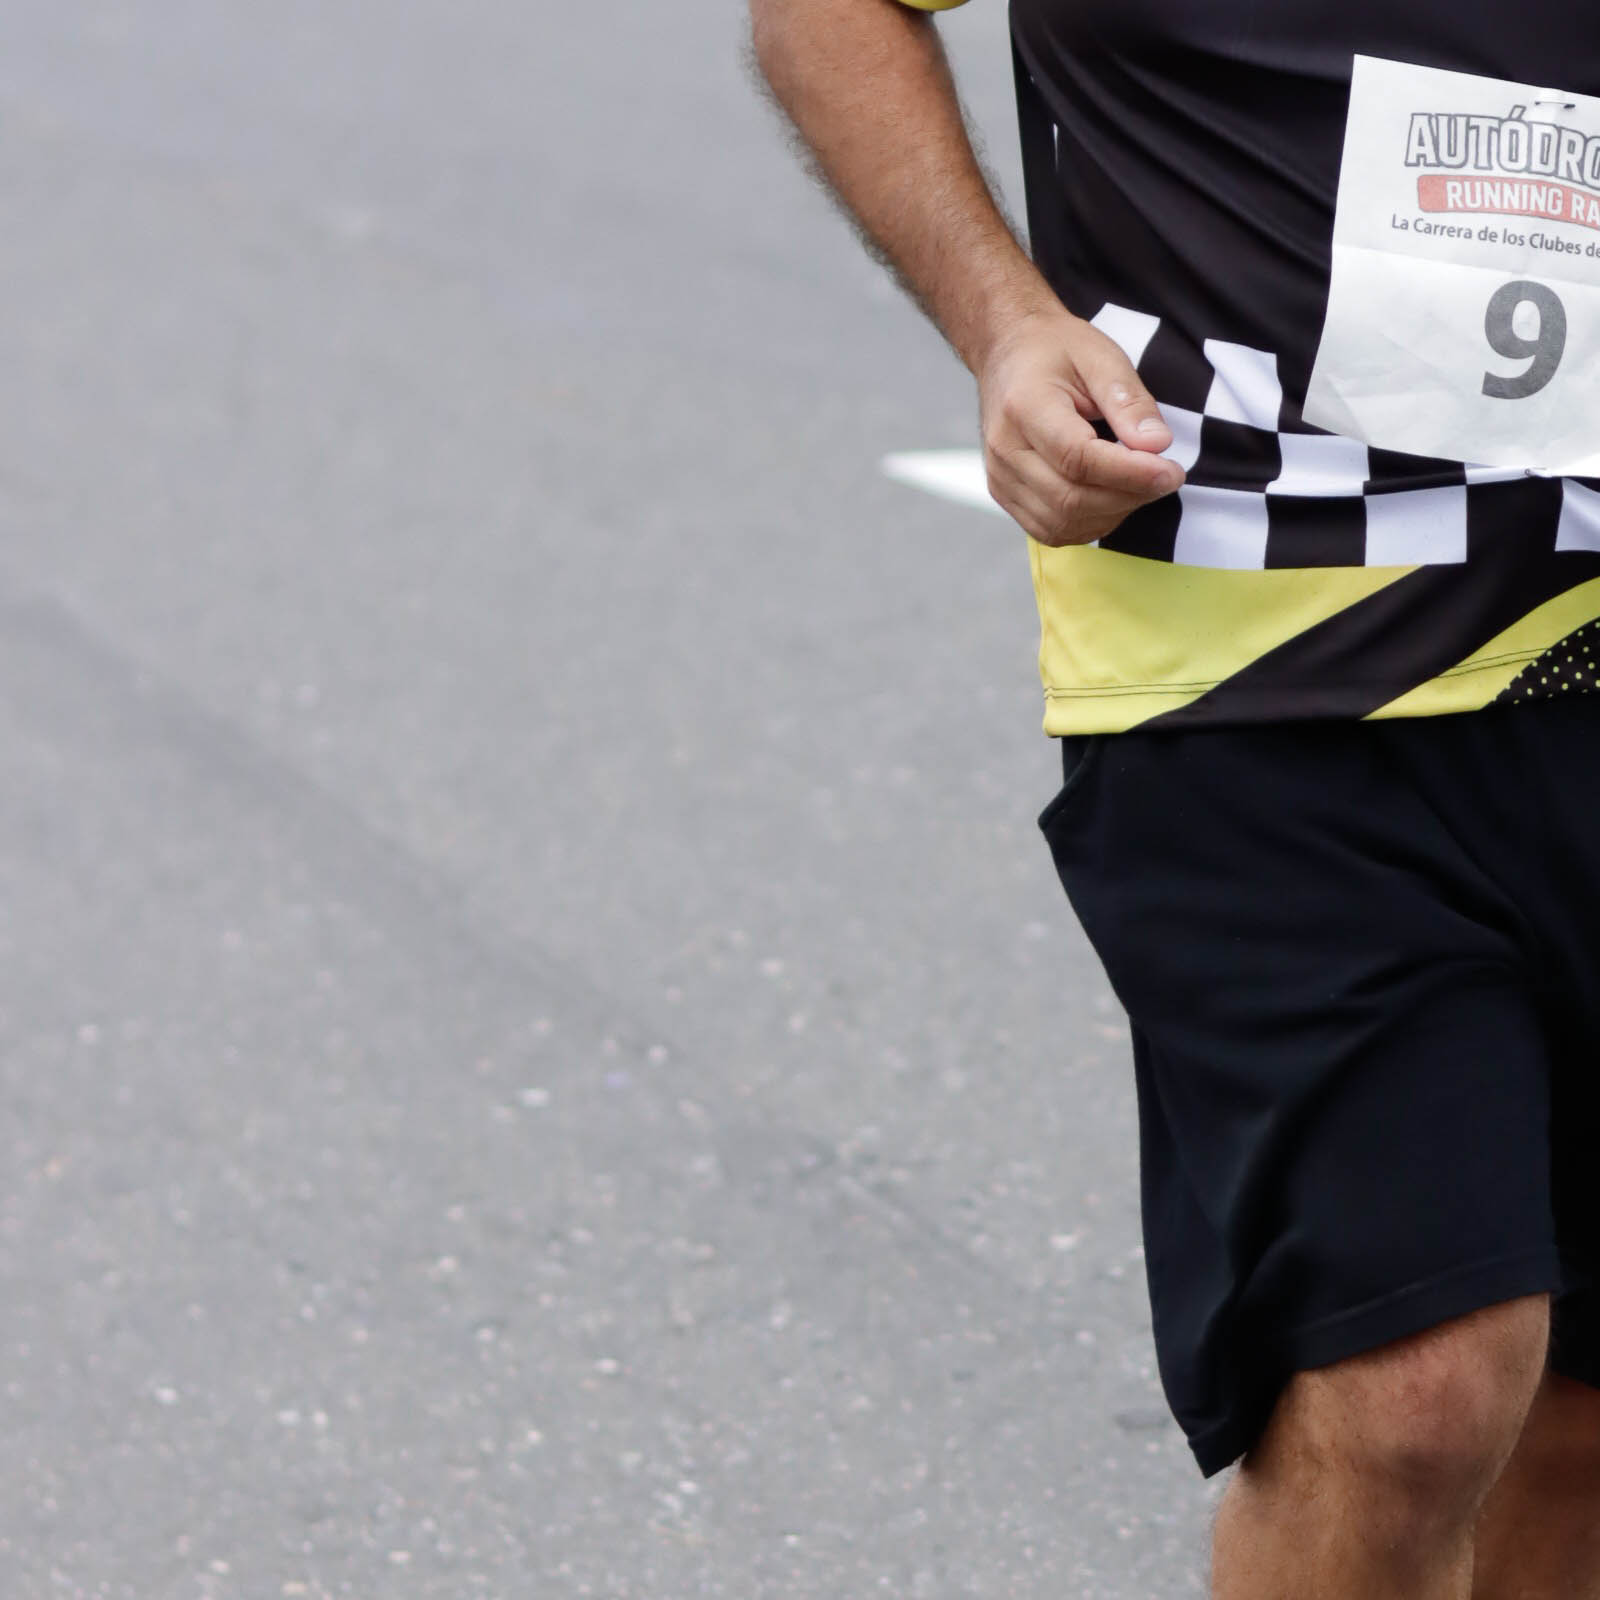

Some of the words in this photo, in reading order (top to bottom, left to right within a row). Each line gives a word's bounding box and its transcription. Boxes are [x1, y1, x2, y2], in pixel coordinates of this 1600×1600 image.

[1446, 180, 1562, 216] RUNNING
[1391, 213, 1409, 231] La
[1413, 217, 1472, 240] Carrera
[1478, 226, 1498, 243] de
[1502, 228, 1525, 246] los
[1529, 233, 1581, 255] Clubes
[1481, 280, 1567, 400] 9
